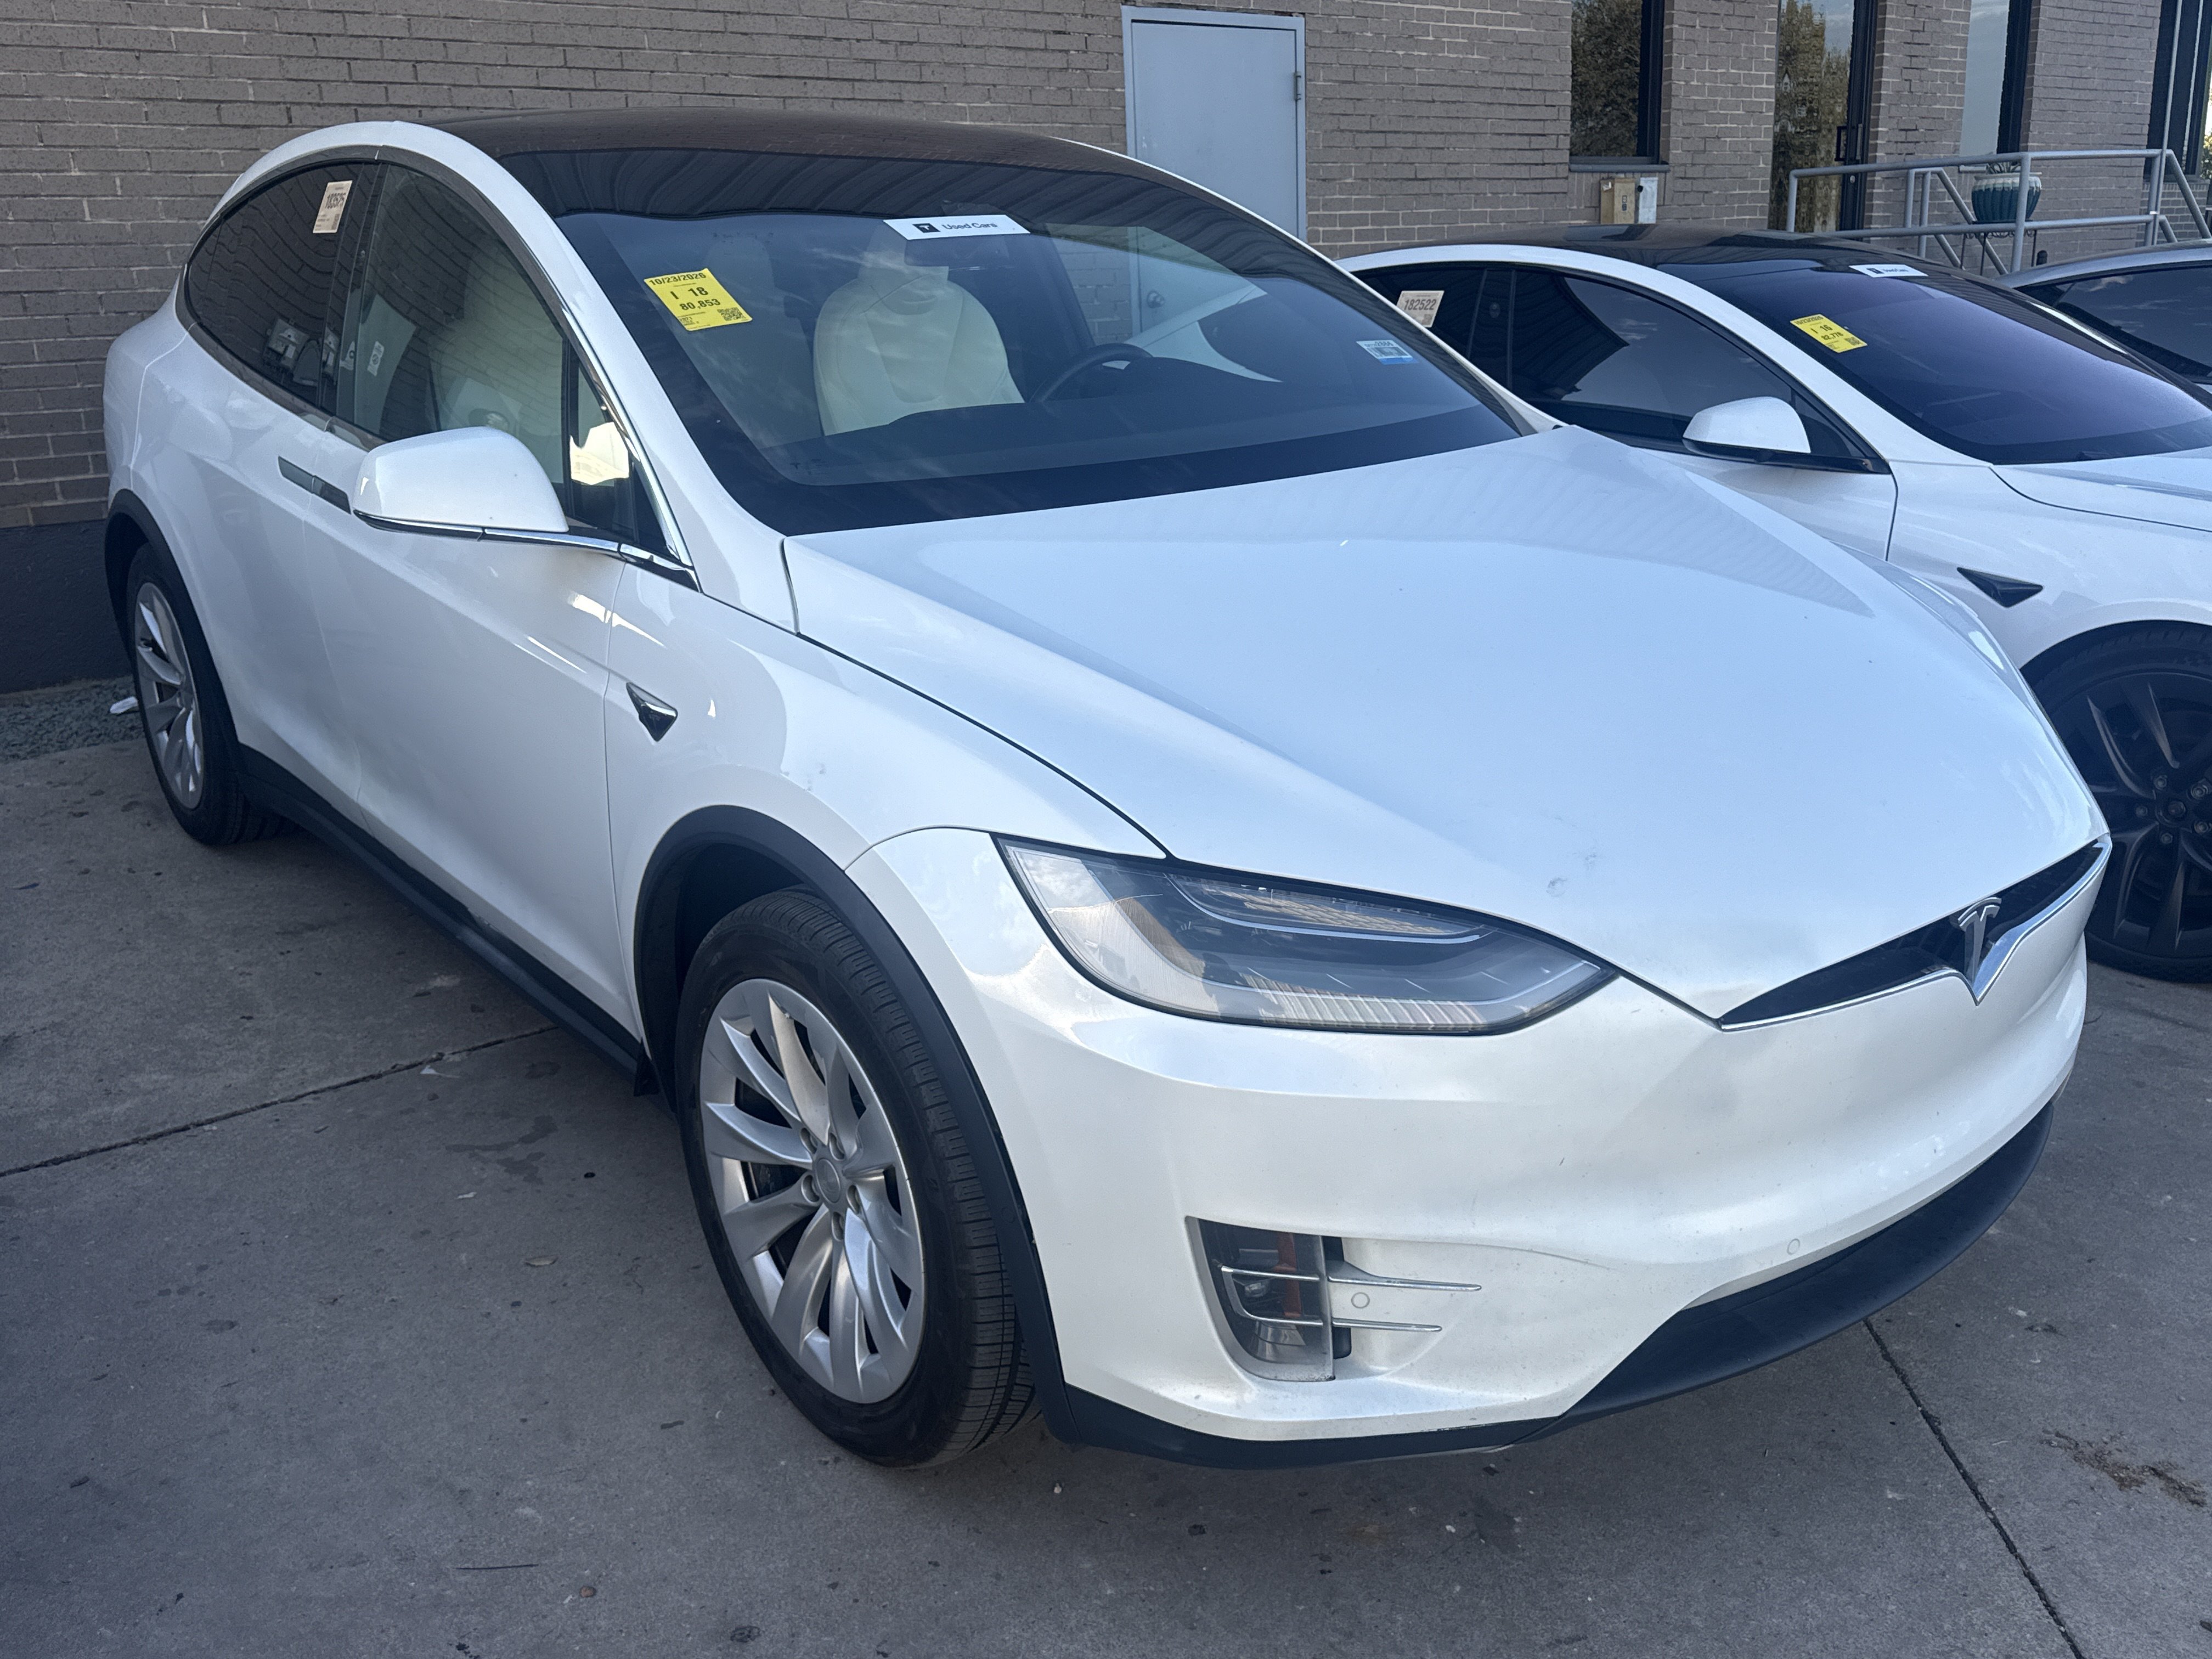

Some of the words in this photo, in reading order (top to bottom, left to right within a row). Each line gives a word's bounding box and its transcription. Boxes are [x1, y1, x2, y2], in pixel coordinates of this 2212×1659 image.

[650, 273, 706, 285] 10/23/2026
[688, 287, 708, 297] 18
[680, 298, 720, 310] 80,853
[1404, 299, 1437, 311] 182522
